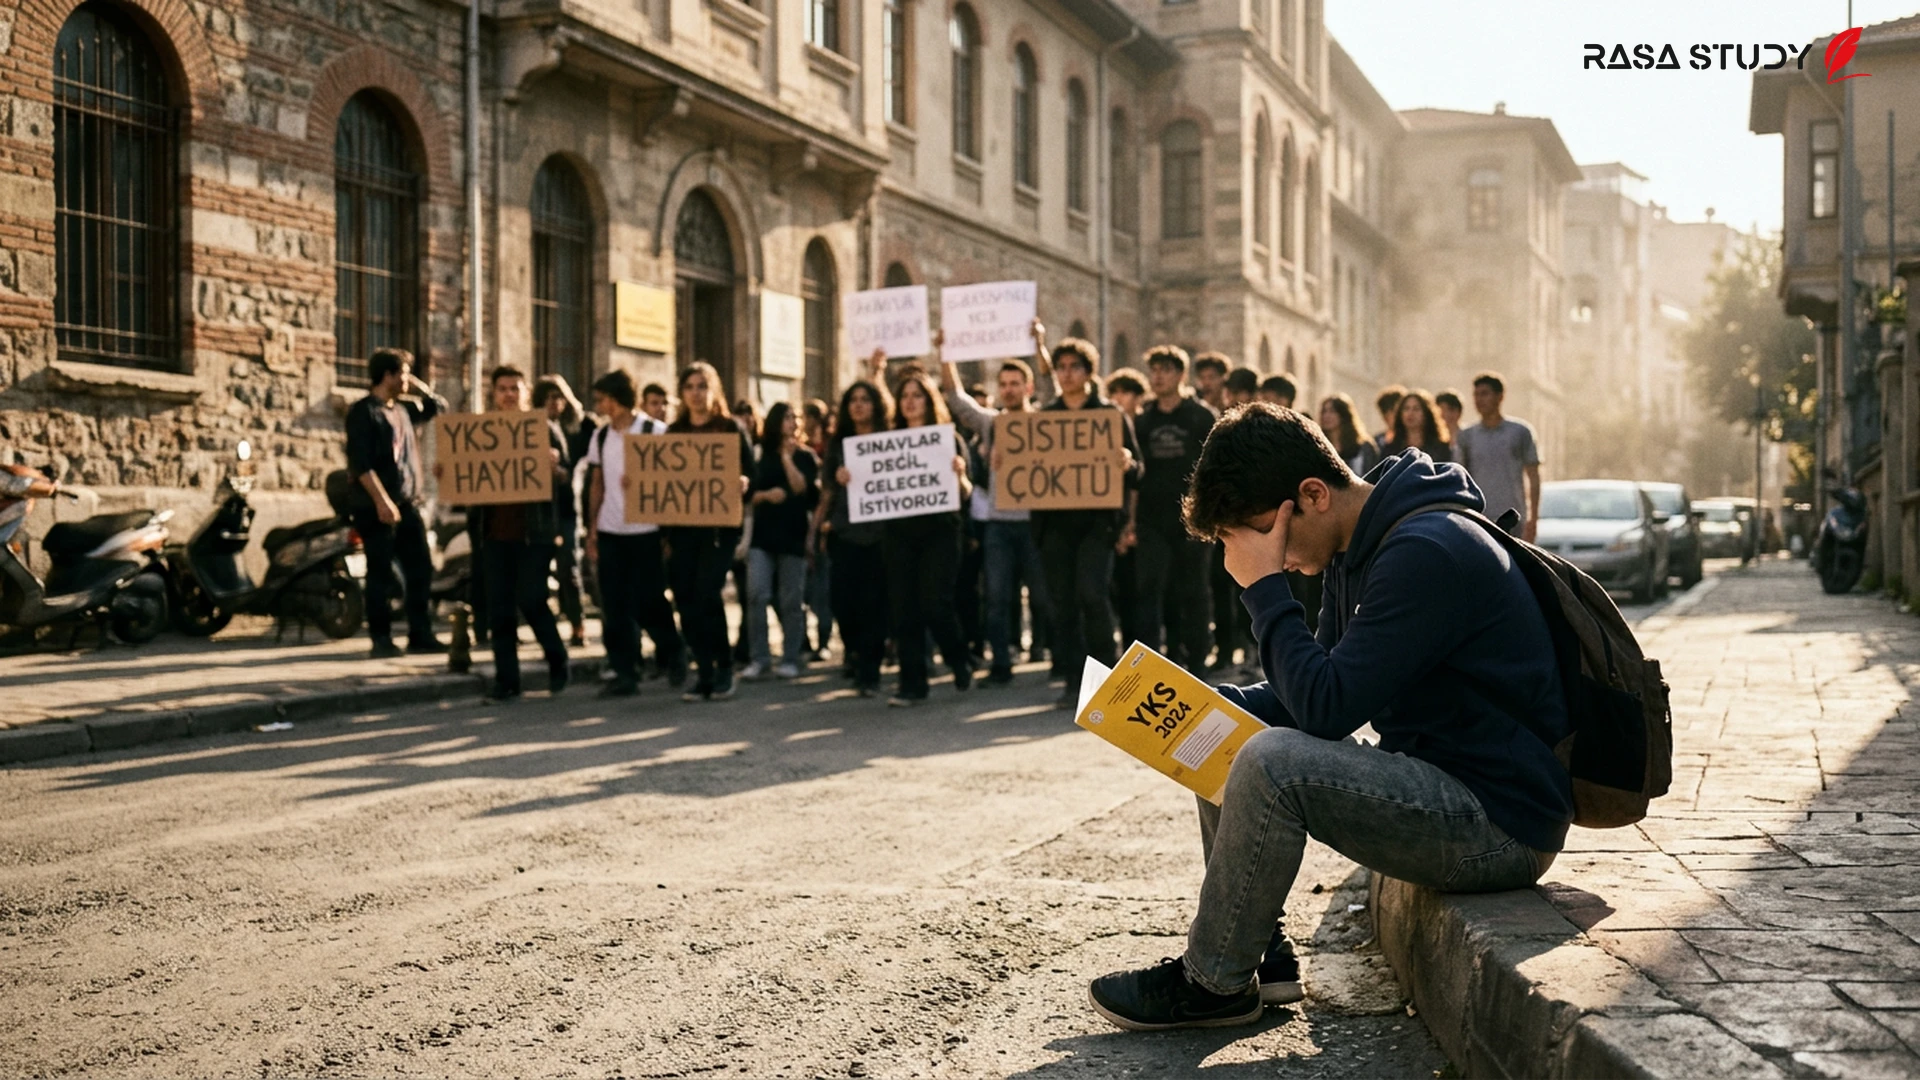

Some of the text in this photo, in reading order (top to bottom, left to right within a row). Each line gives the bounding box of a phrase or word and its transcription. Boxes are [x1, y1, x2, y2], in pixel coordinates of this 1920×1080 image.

[444, 418, 539, 451] YKS'YE
[856, 432, 941, 456] SINAVLAR
[1006, 418, 1114, 454] SİSTEM
[633, 439, 725, 471] YKS'YE
[455, 457, 542, 493] HAYIR
[864, 472, 940, 495] GELECEK
[1006, 456, 1111, 503] ÇÖKTÜ
[638, 478, 729, 514] HAYIR
[859, 491, 949, 516] İSTİYORUZ
[1127, 682, 1177, 727] YKS
[1154, 701, 1192, 739] 2024
